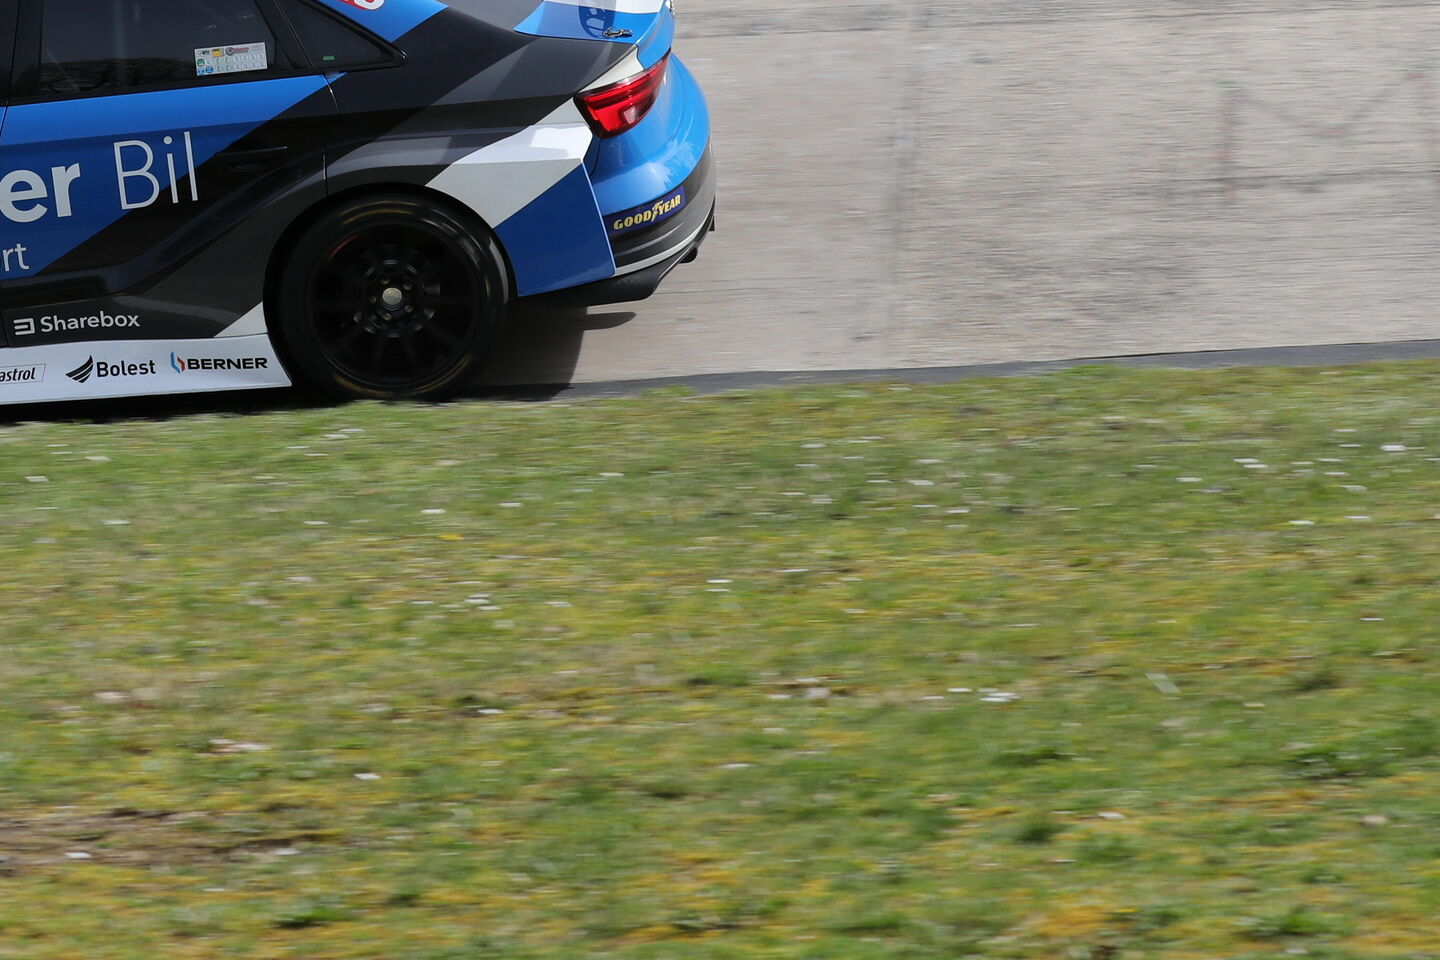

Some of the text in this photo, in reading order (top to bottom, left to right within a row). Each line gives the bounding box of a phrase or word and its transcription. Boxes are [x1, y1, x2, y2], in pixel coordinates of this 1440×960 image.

[113, 131, 199, 210] Bil
[40, 310, 141, 333] Sharebox
[96, 359, 157, 378] Bolest
[186, 357, 268, 371] BERNER
